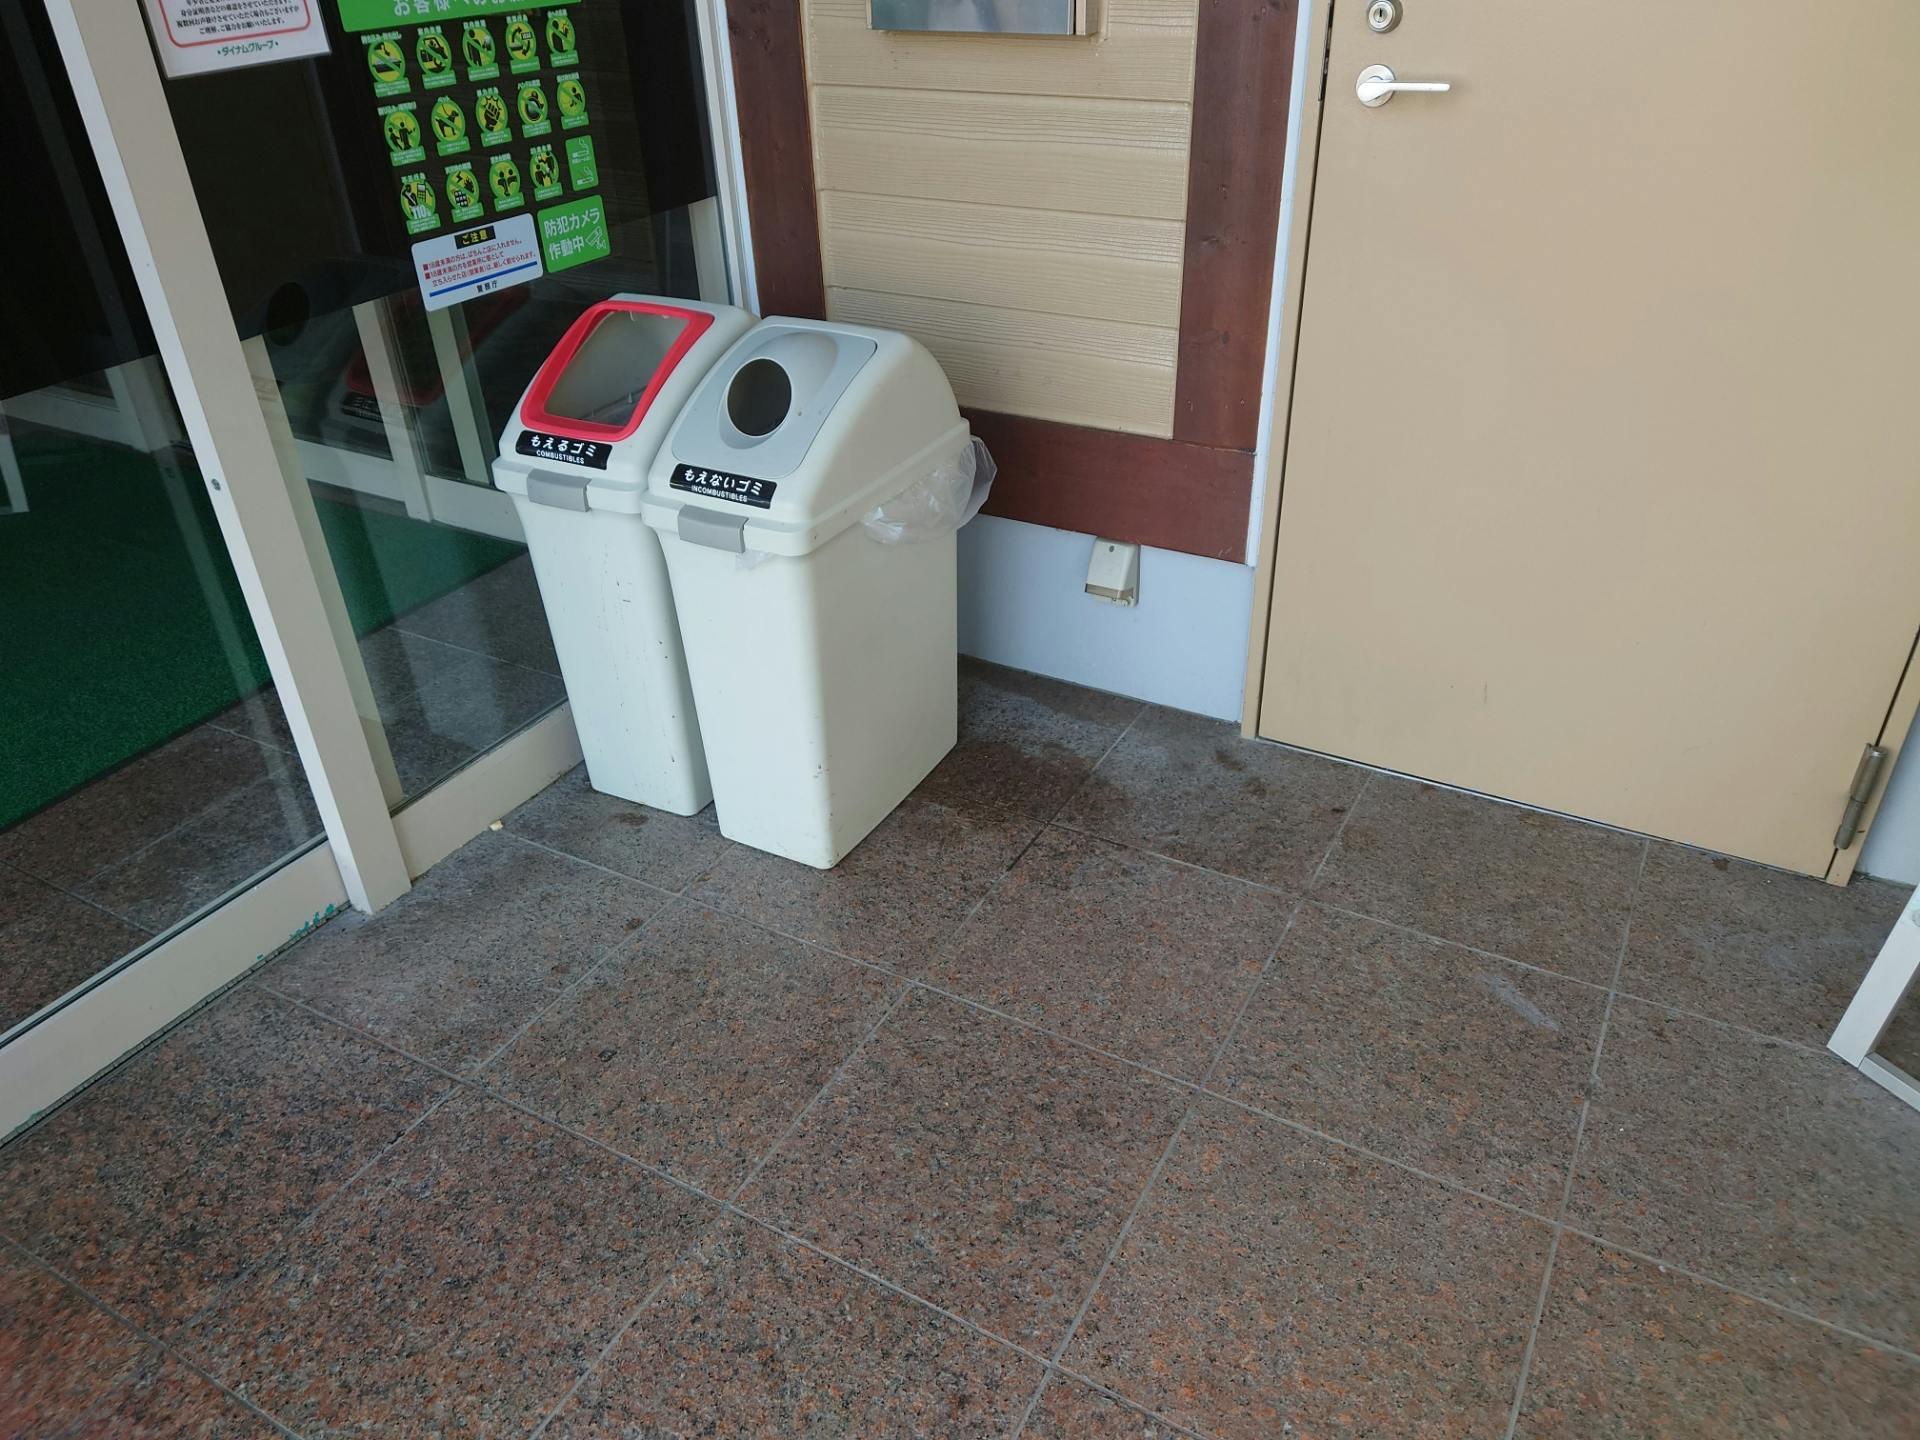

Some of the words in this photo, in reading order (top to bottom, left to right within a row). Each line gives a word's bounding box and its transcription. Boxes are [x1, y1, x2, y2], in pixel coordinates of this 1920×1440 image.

[544, 207, 601, 238] 防犯カメラ
[461, 229, 489, 245] ご注意
[549, 235, 585, 261] 作動中
[530, 434, 598, 458] もえるゴミ
[536, 449, 585, 465] COMBUSTIBLES
[683, 468, 764, 496] もえないゴミ
[691, 485, 748, 503] INCOMBUSTIBLES
